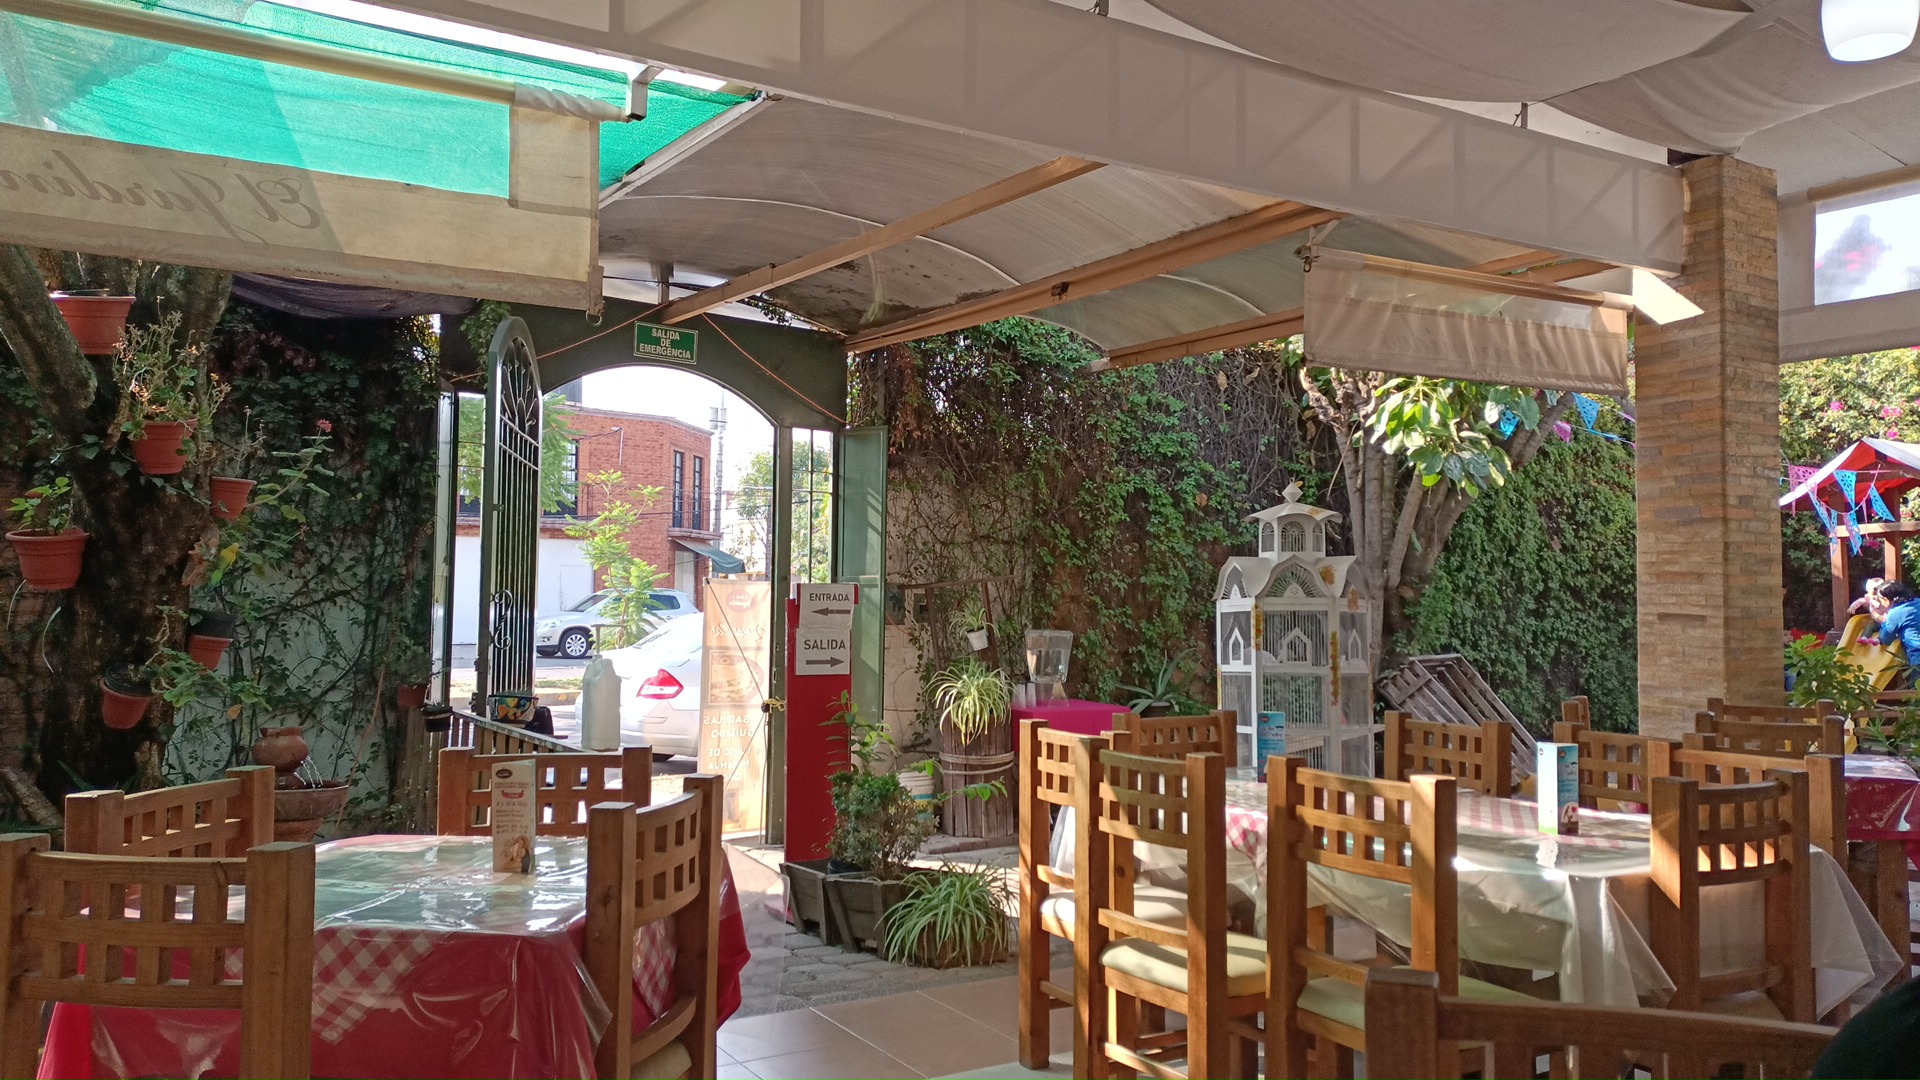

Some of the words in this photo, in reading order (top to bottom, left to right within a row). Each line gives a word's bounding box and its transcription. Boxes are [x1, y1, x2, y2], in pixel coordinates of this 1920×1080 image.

[652, 328, 680, 340] SALIDA
[661, 338, 671, 347] DE
[640, 343, 691, 359] EMERGENCIA
[809, 592, 849, 602] ENTRADA
[804, 639, 846, 650] SALIDA
